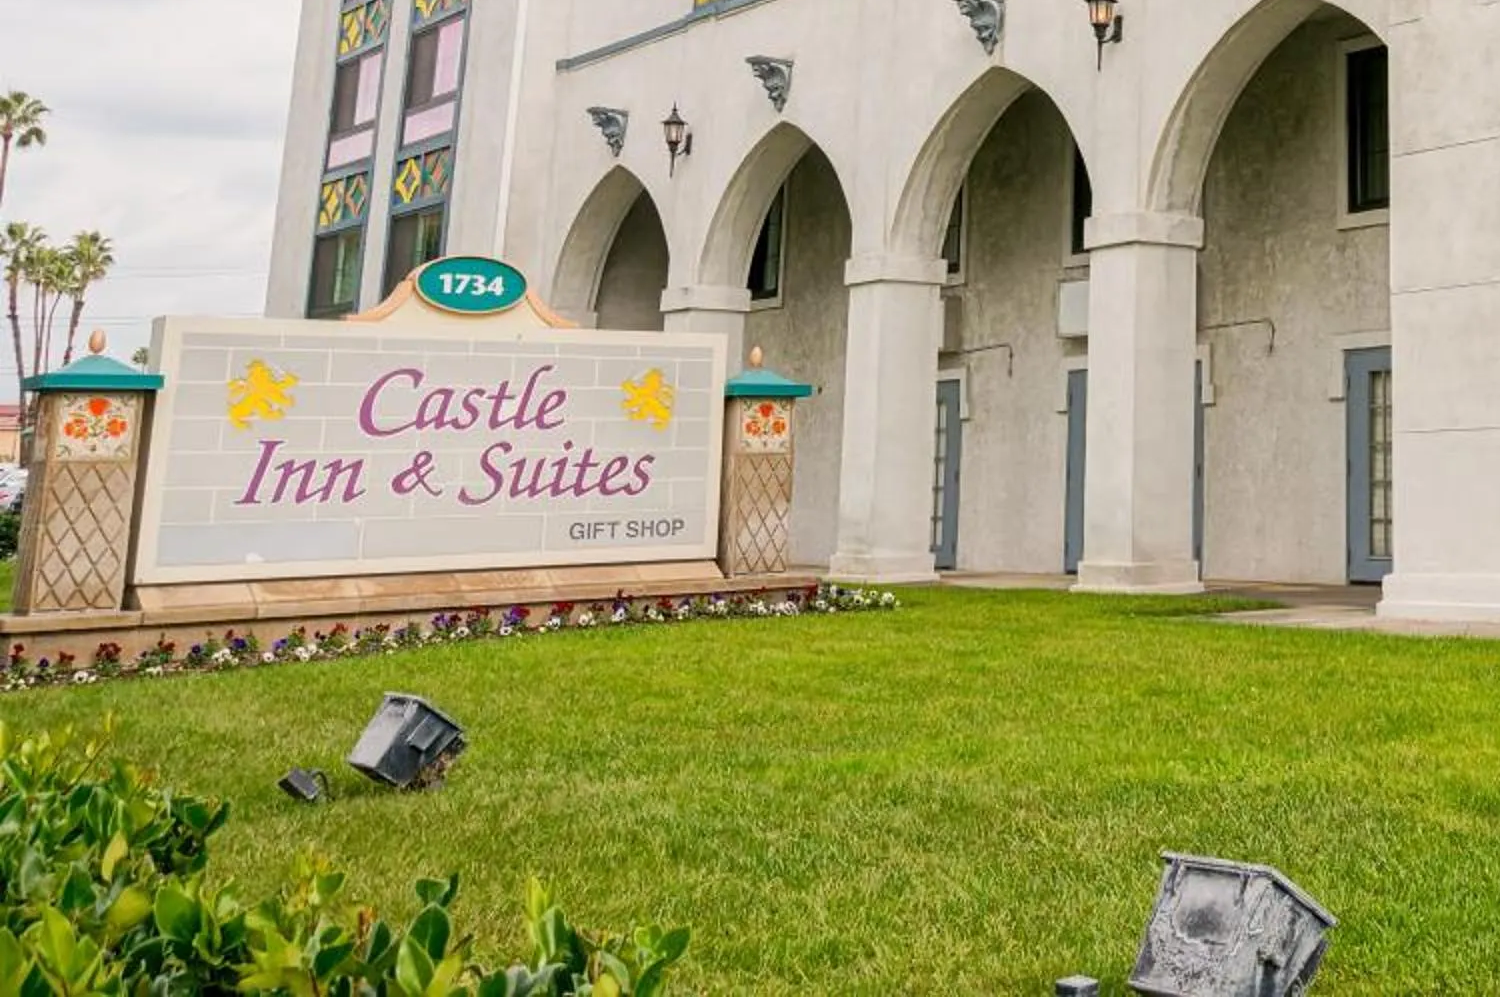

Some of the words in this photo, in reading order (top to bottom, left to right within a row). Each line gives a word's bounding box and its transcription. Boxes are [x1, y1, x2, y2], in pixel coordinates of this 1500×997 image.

[438, 270, 506, 298] 1734
[358, 363, 568, 437] Castle
[234, 439, 366, 506] Inn
[391, 451, 443, 496] &
[458, 440, 656, 506] Suites
[568, 521, 619, 542] GIFT
[625, 518, 685, 540] SHOP
